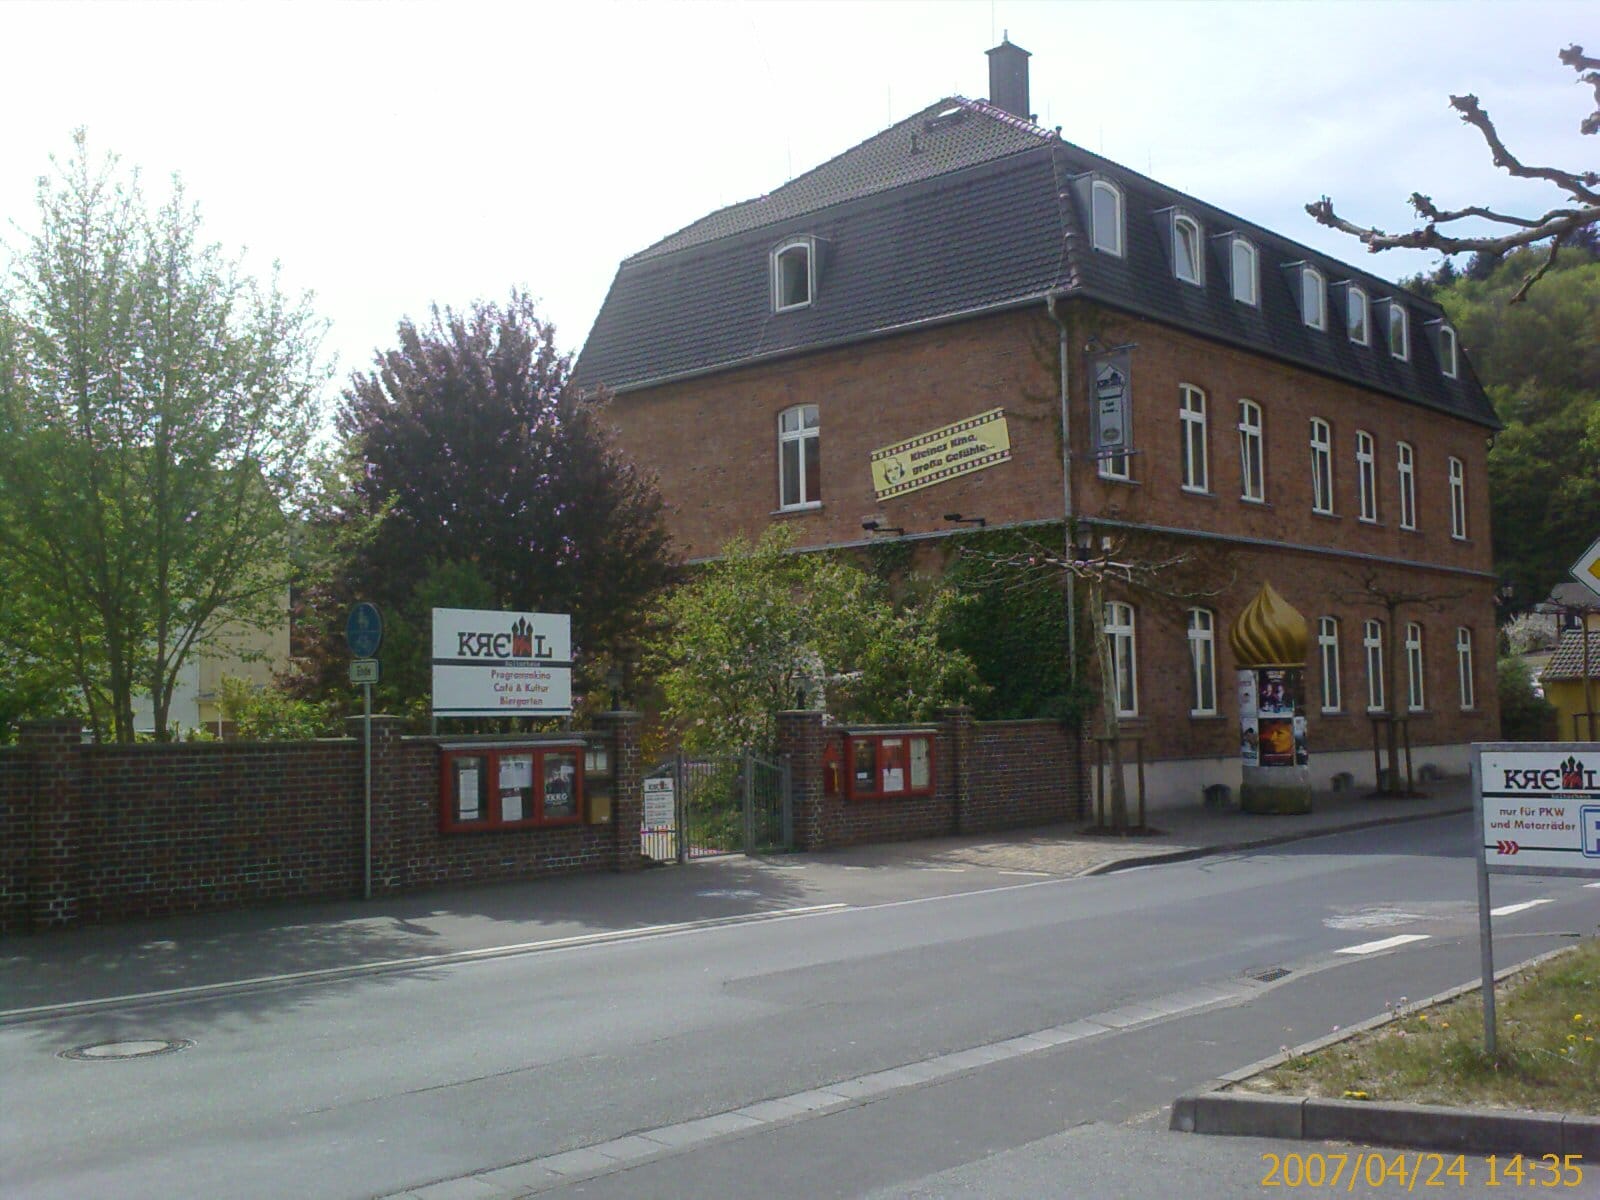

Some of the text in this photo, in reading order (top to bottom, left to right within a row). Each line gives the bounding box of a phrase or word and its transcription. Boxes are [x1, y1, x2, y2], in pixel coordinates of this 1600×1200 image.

[516, 684, 522, 692] &
[525, 683, 549, 693] Kultur
[500, 696, 544, 707] Biergarten
[1499, 806, 1565, 817] nur für PKW
[1490, 819, 1576, 831] und Motorräder
